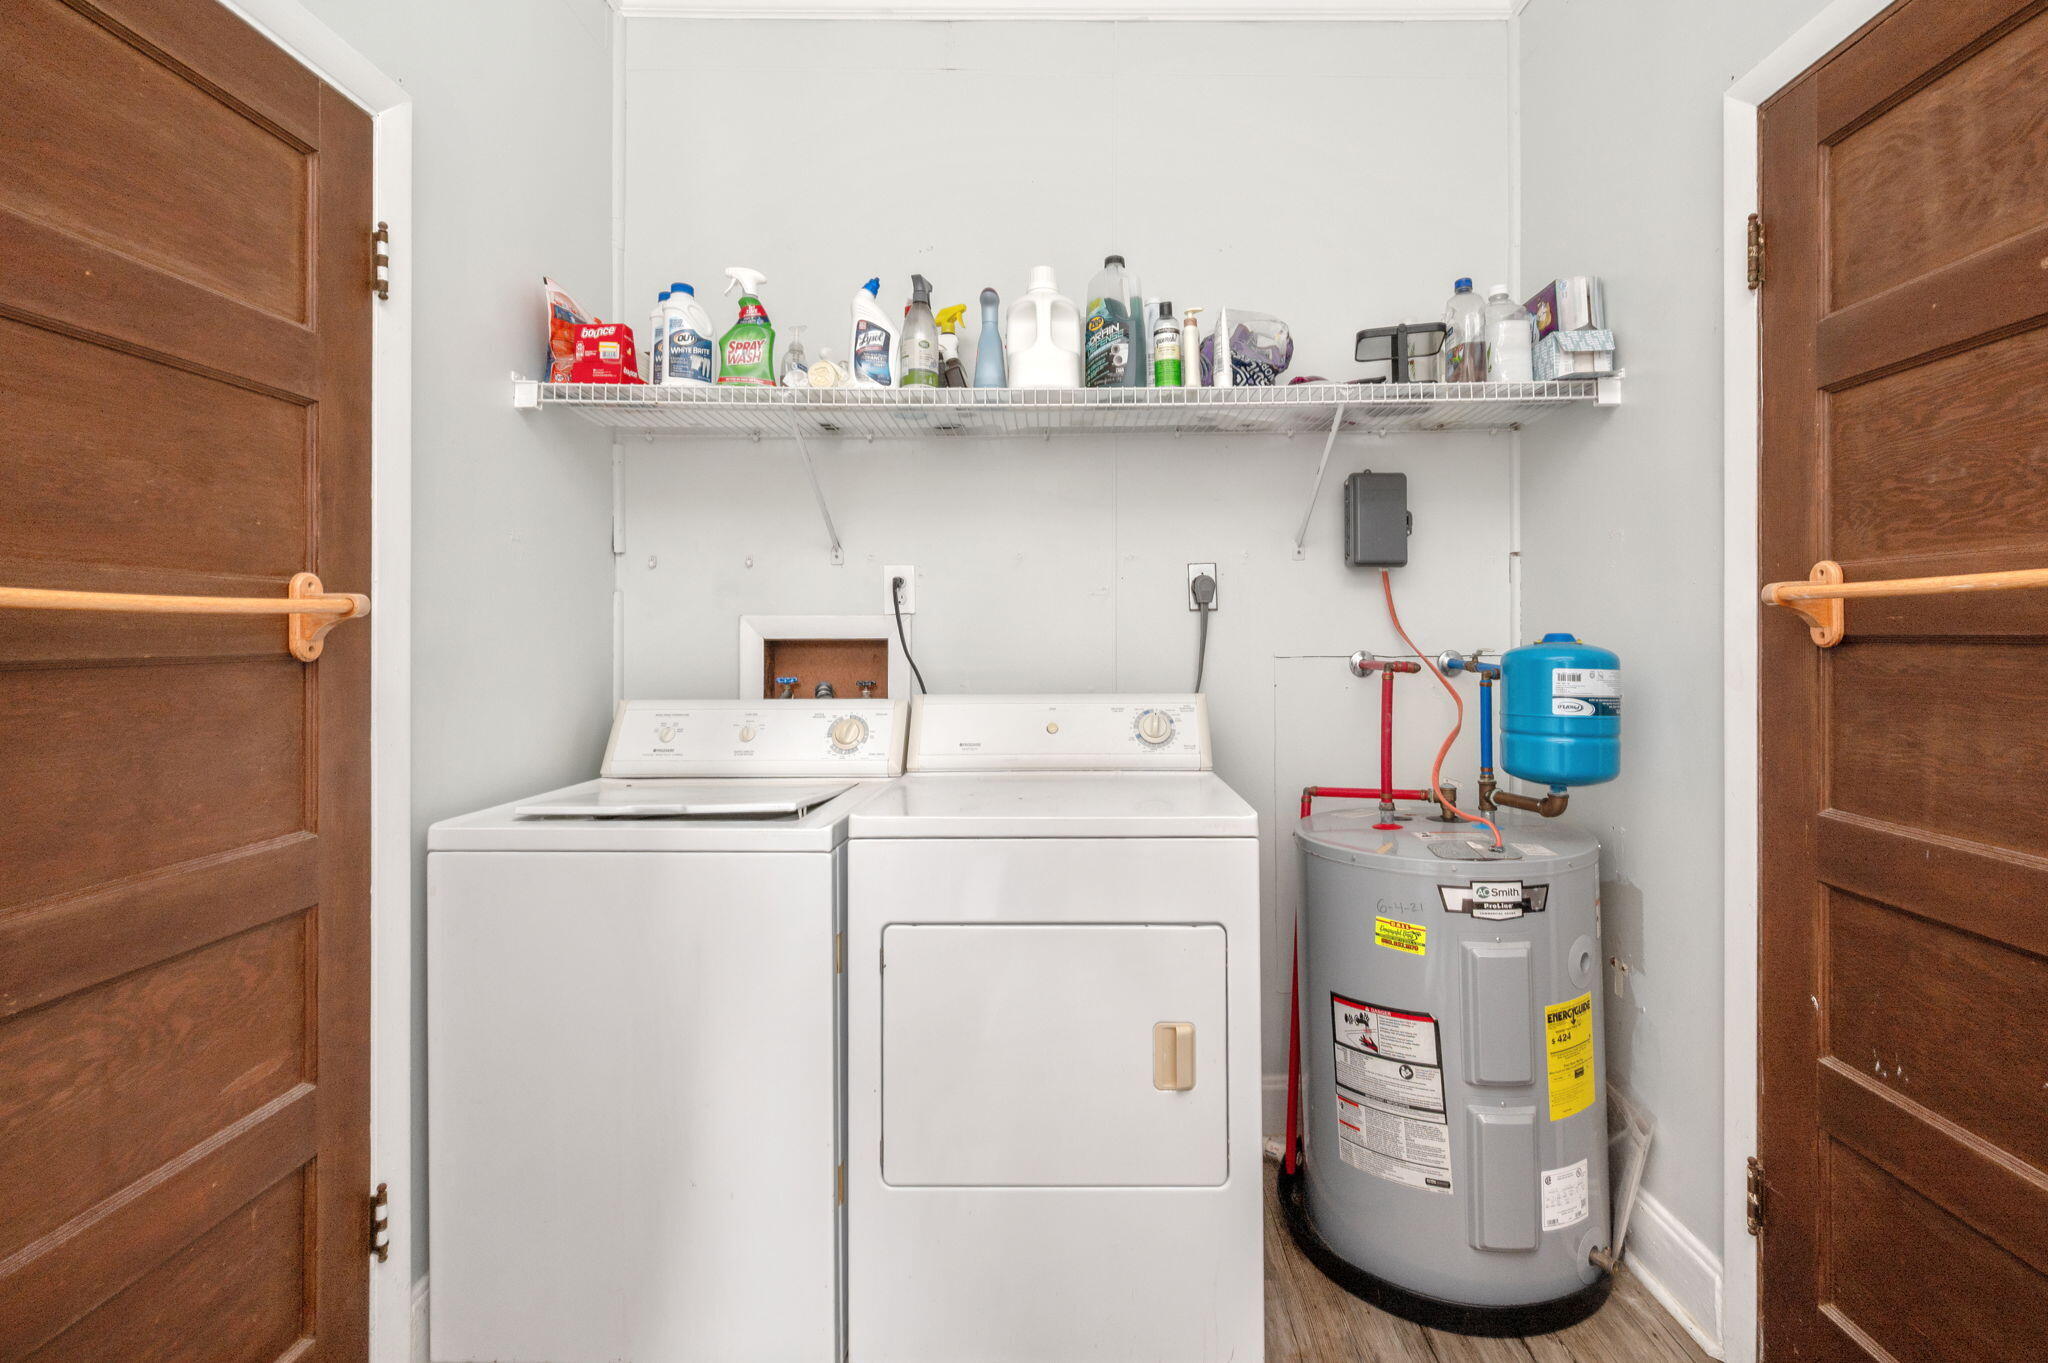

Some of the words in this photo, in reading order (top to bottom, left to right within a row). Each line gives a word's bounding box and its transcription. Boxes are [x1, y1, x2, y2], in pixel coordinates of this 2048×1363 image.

[581, 326, 616, 339] bounce
[692, 347, 710, 355] BRITE
[729, 340, 765, 352] SPRAY
[728, 350, 762, 364] WASH
[1491, 888, 1519, 897] Smith
[1370, 1007, 1392, 1016] DANGER
[1557, 1032, 1571, 1043] 424
